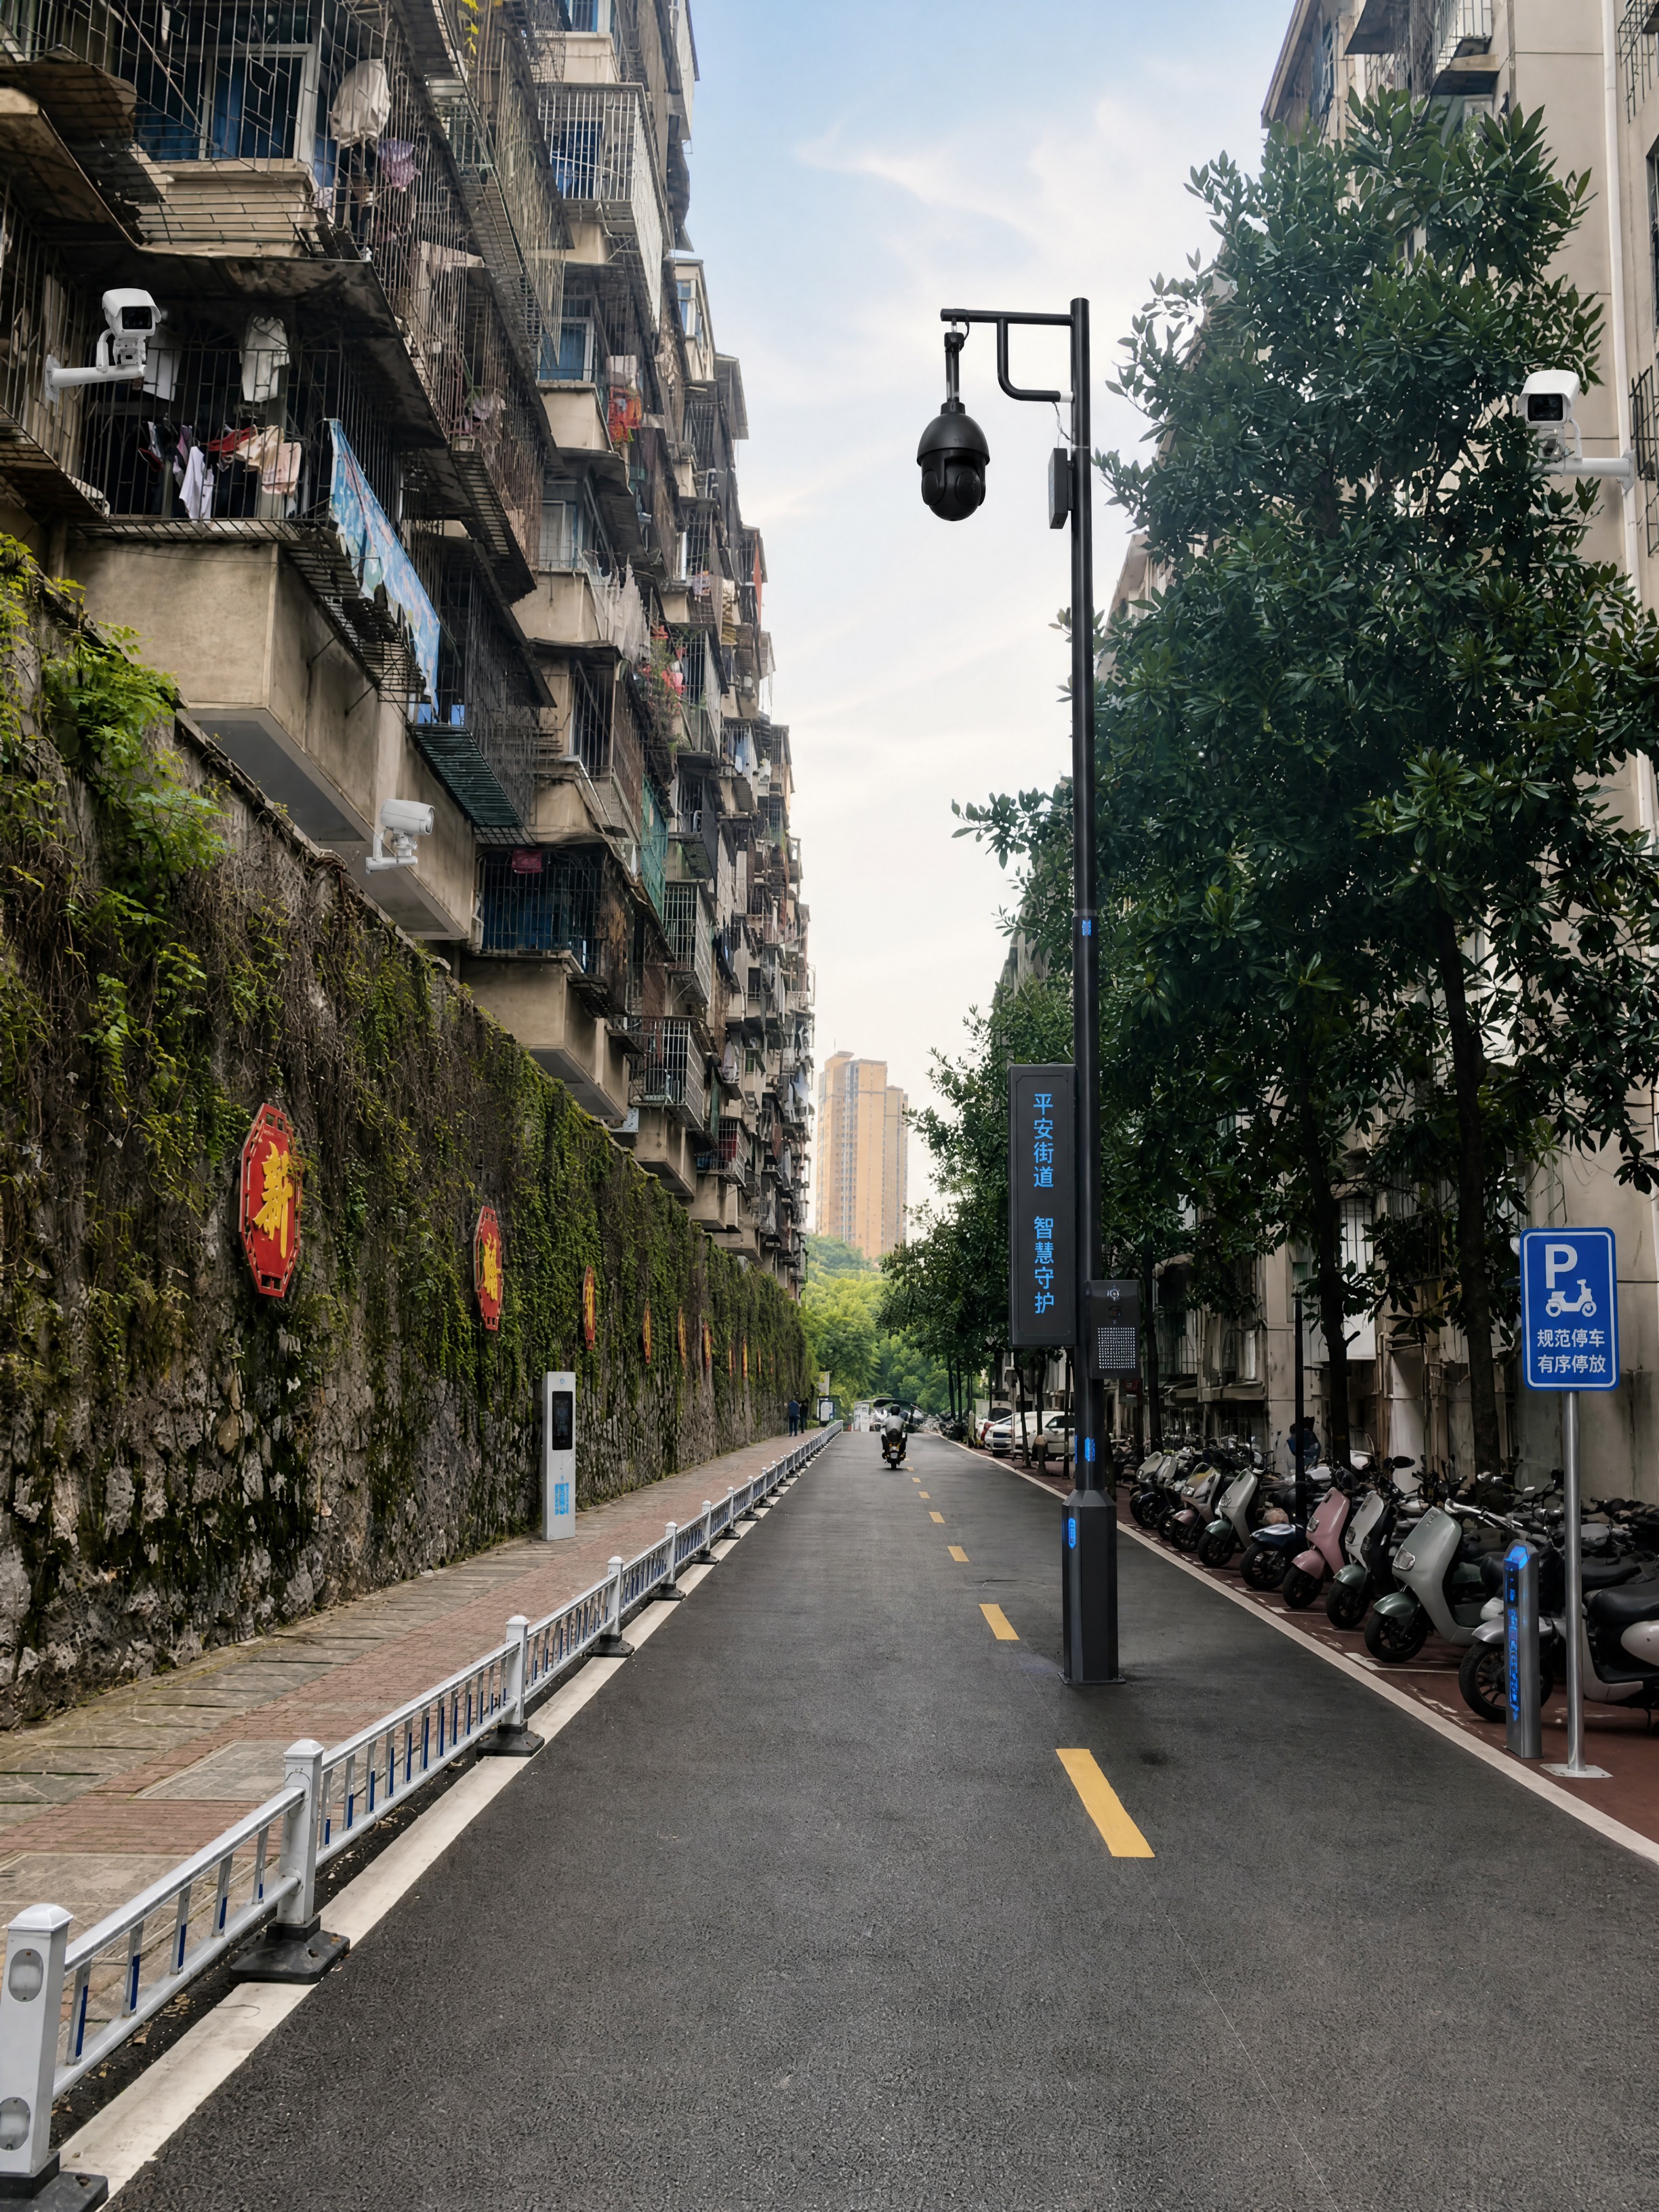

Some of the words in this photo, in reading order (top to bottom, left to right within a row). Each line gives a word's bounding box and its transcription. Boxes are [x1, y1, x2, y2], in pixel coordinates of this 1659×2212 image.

[1033, 1093, 1054, 1187] 平安街道
[1033, 1216, 1054, 1314] 智慧守护
[1545, 1244, 1578, 1289] P
[1537, 1328, 1605, 1348] 规范停车
[1537, 1354, 1606, 1374] 有序停放
